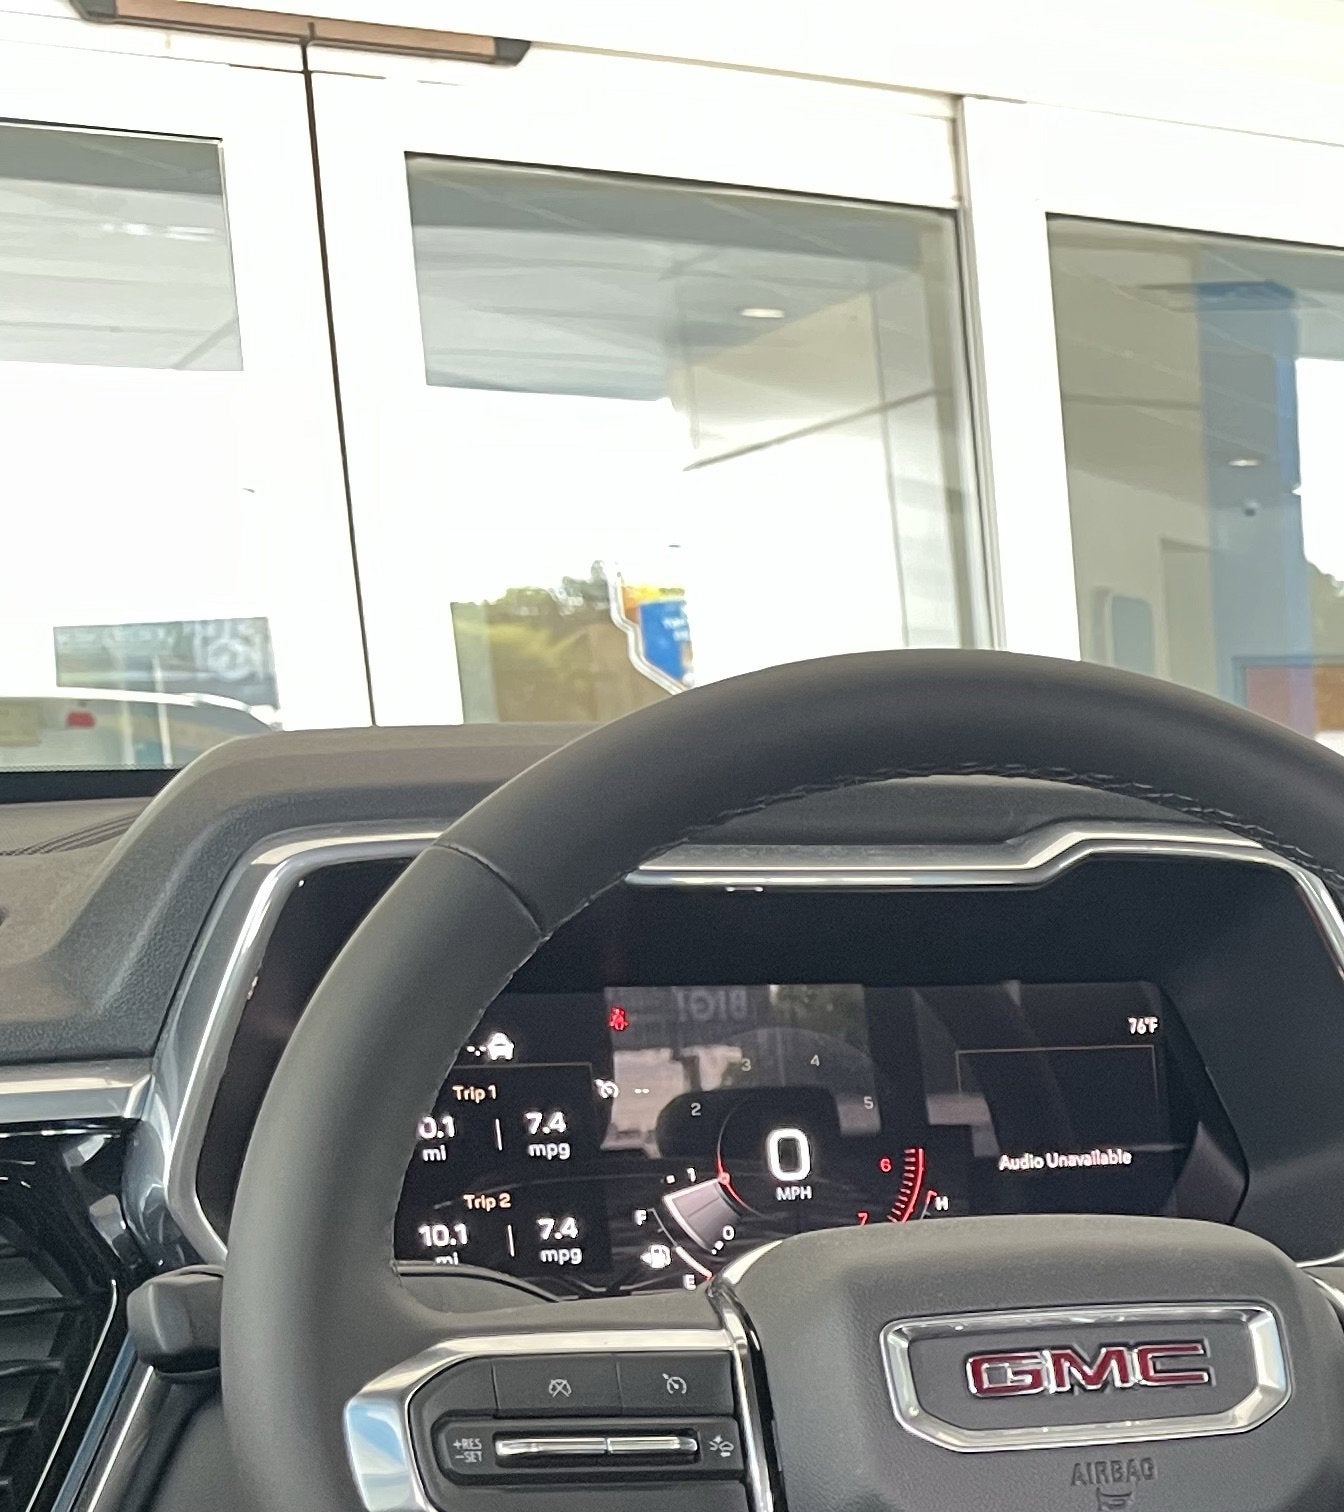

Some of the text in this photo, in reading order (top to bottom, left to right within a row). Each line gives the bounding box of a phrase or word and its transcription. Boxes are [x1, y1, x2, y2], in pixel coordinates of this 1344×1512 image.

[741, 1057, 751, 1071] 3
[810, 1055, 820, 1068] 4
[452, 1084, 497, 1104] Trip 1
[863, 1096, 874, 1110] 5
[690, 1103, 702, 1117] 2
[525, 1111, 568, 1135] 7.4
[422, 1142, 571, 1162] mi mpg
[766, 1127, 812, 1182] 0
[999, 1148, 1133, 1171] Audio Unavailable
[879, 1158, 892, 1172] 6
[463, 1192, 512, 1212] Trip 2
[775, 1185, 813, 1201] MPH
[418, 1217, 579, 1247] 10.1 7.4
[540, 1248, 583, 1265] mpg
[966, 1343, 1210, 1398] GMC
[1071, 1456, 1156, 1487] AIRBAG
